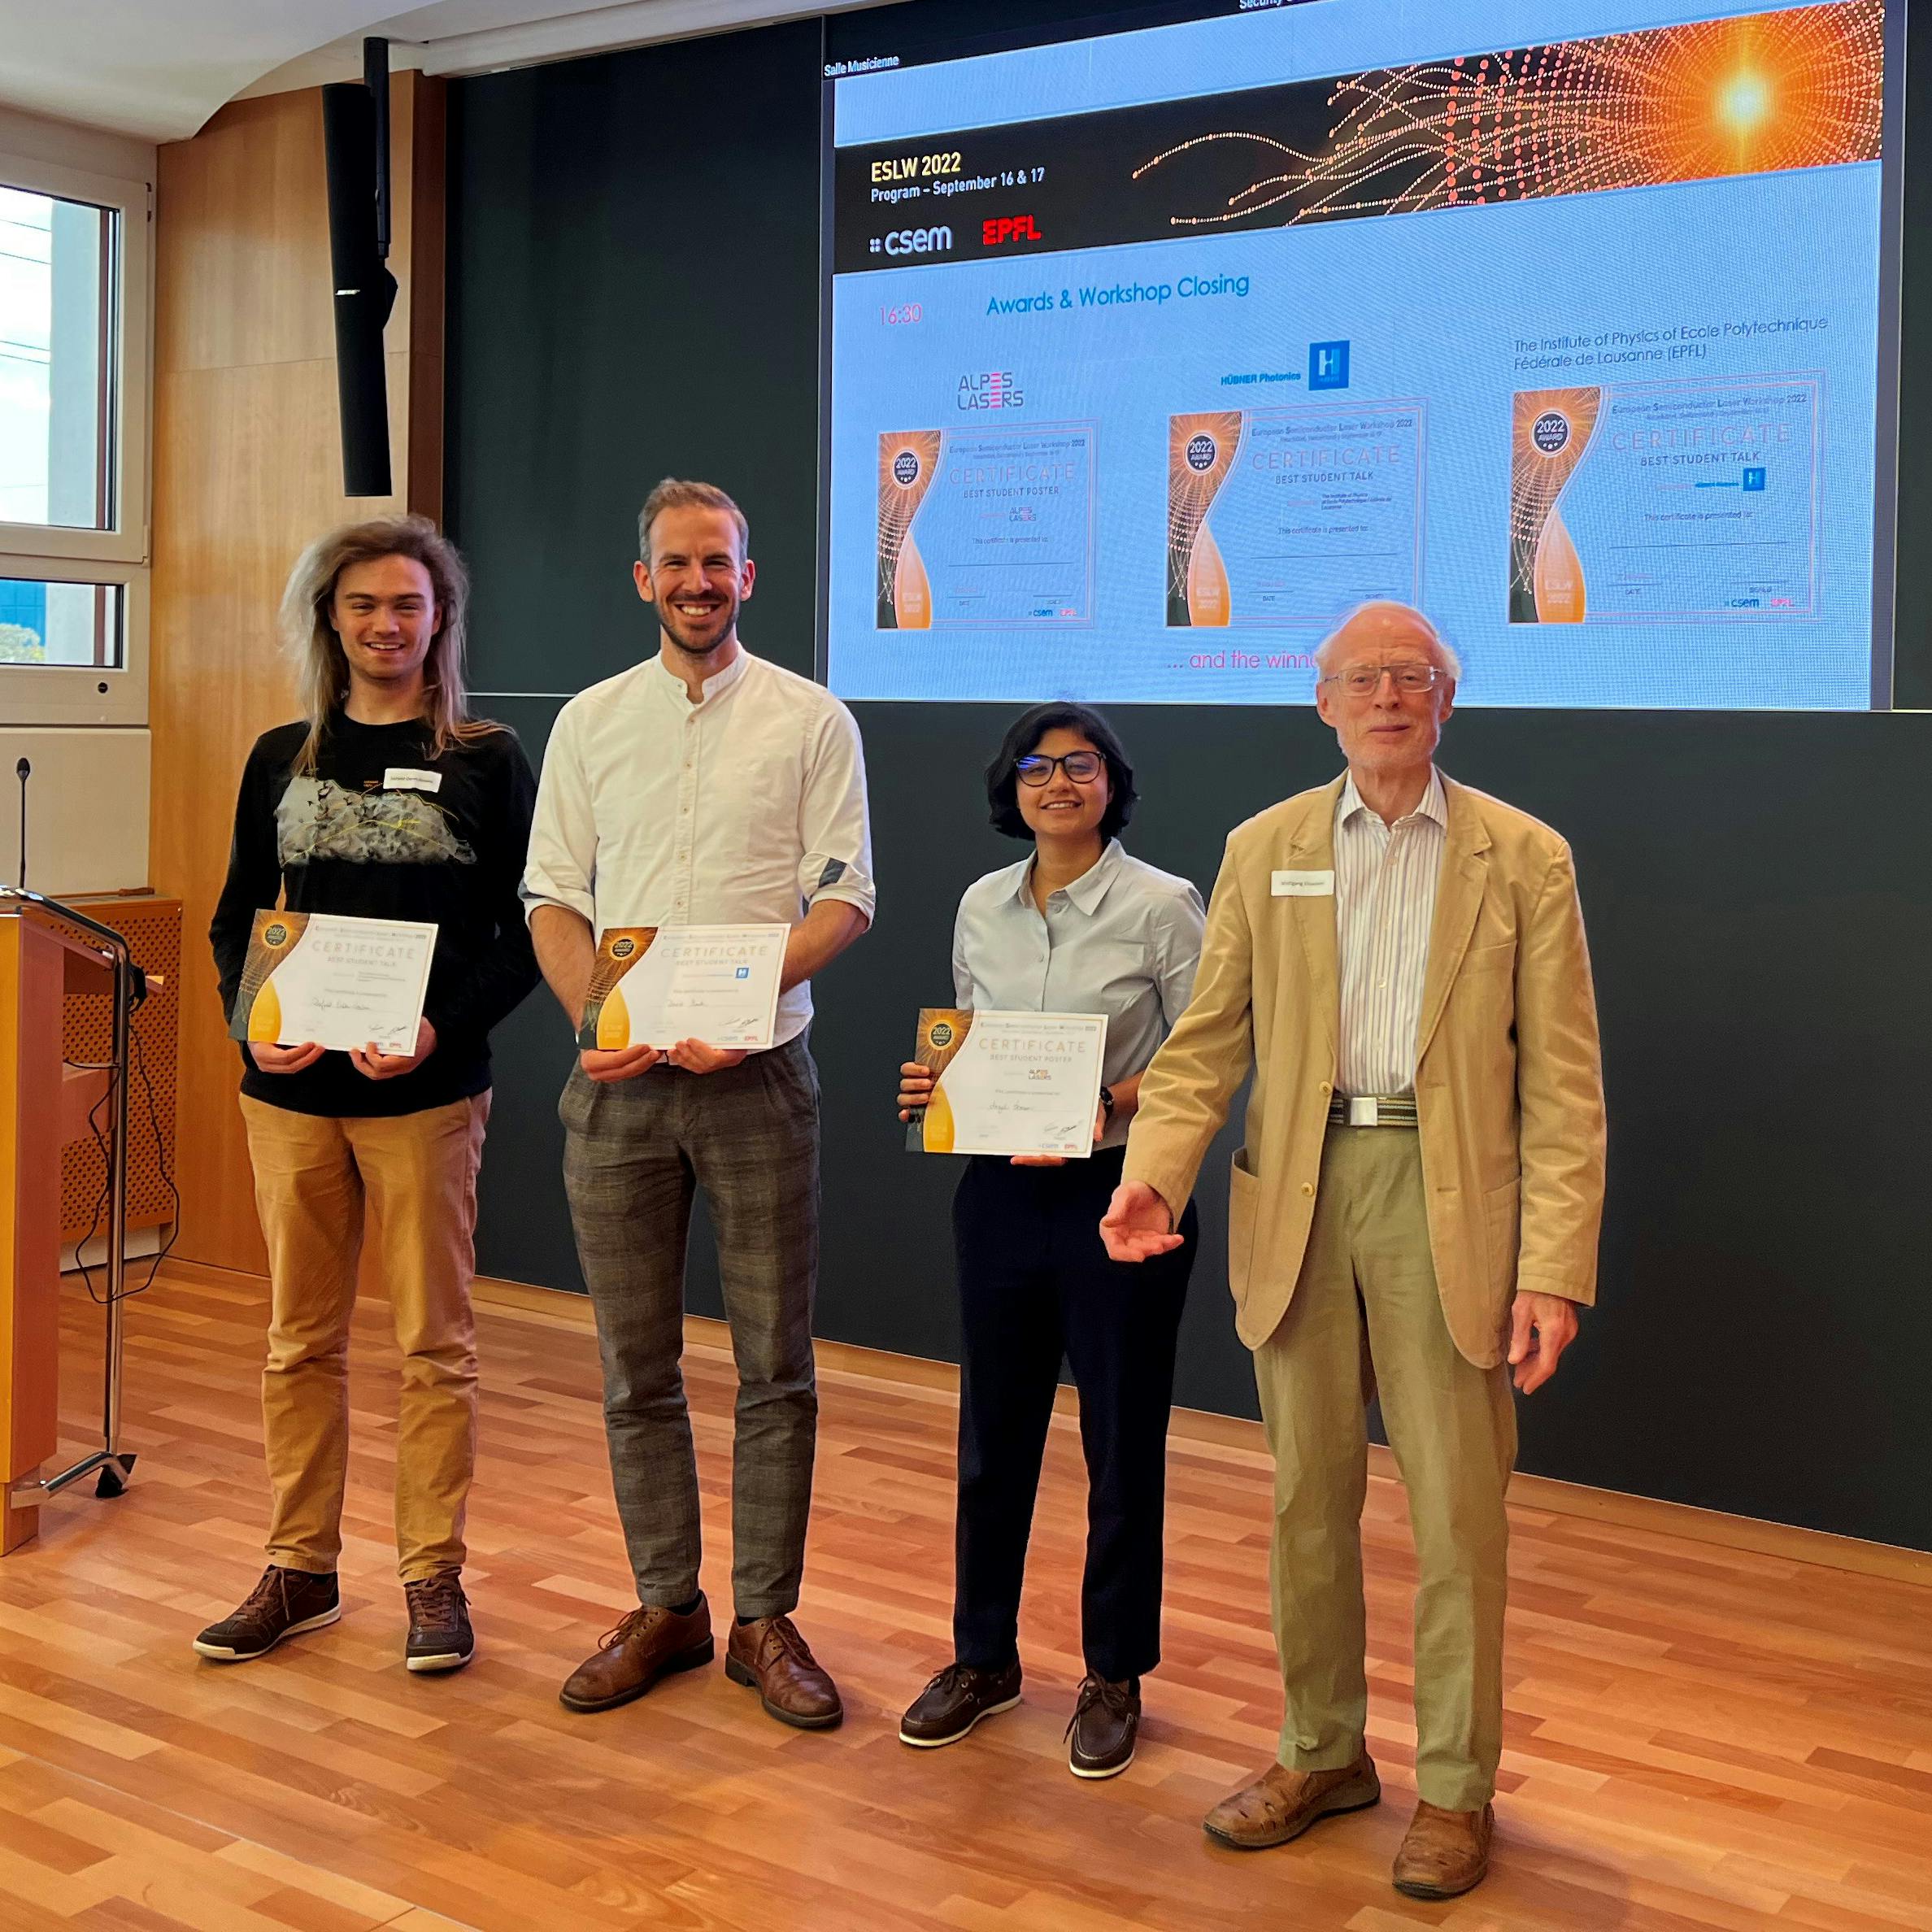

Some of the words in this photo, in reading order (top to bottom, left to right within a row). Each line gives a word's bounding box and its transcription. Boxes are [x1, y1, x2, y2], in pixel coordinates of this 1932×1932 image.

[825, 63, 846, 76] Salle
[848, 56, 899, 72] Musicienne
[871, 156, 918, 182] ESLW
[921, 151, 962, 176] 2022
[871, 186, 920, 204] Program
[933, 176, 997, 197] September
[1000, 171, 1013, 186] 16
[1016, 169, 1027, 185] &
[1031, 167, 1045, 182] 17
[982, 214, 1042, 246] EPFL
[885, 225, 952, 255] csem
[986, 291, 1053, 315] Awards
[1060, 289, 1073, 309] &
[1079, 279, 1172, 306] Workshop
[1177, 273, 1249, 298] Closing
[879, 302, 923, 325] 16:30
[1515, 340, 1537, 352] The
[1540, 335, 1591, 350] Institute
[1595, 333, 1608, 346] of
[1612, 330, 1660, 346] Physics
[1663, 327, 1677, 340] of
[1681, 325, 1719, 339] Ecole
[1724, 317, 1829, 337] Polytechnique
[1514, 355, 1572, 370] Fédérale
[1575, 354, 1594, 366] de
[1598, 350, 1663, 364] Lausanne
[1669, 344, 1706, 361] (EPFL)
[958, 372, 1013, 391] ALPES
[1221, 374, 1256, 385] HÜBNER
[1259, 372, 1301, 383] Photonics
[957, 390, 1024, 410] LASERS
[1787, 394, 1807, 403] 2022
[1537, 420, 1564, 433] 2022
[1612, 423, 1794, 450] CERTIFICATE
[1190, 441, 1212, 453] 2022
[896, 457, 916, 468] 2022
[1252, 445, 1401, 470] CERTIFICATE
[1641, 455, 1668, 466] BEST
[1672, 453, 1729, 464] STUDENT
[1730, 451, 1760, 463] TALK
[950, 462, 1075, 485] CERTIFICATE
[1275, 474, 1298, 484] BEST
[1302, 472, 1347, 483] STUDENT
[1350, 471, 1373, 481] TALK
[964, 490, 983, 498] BEST
[986, 488, 1024, 498] STUDENT
[1026, 486, 1060, 495] POSTER
[1731, 598, 1759, 607] csem
[1190, 651, 1225, 668] and
[1230, 651, 1260, 668] the
[312, 940, 416, 959] CERTIFICATE
[660, 946, 768, 959] CERTIFICATE
[979, 1038, 1086, 1053] CERTIFICATE
